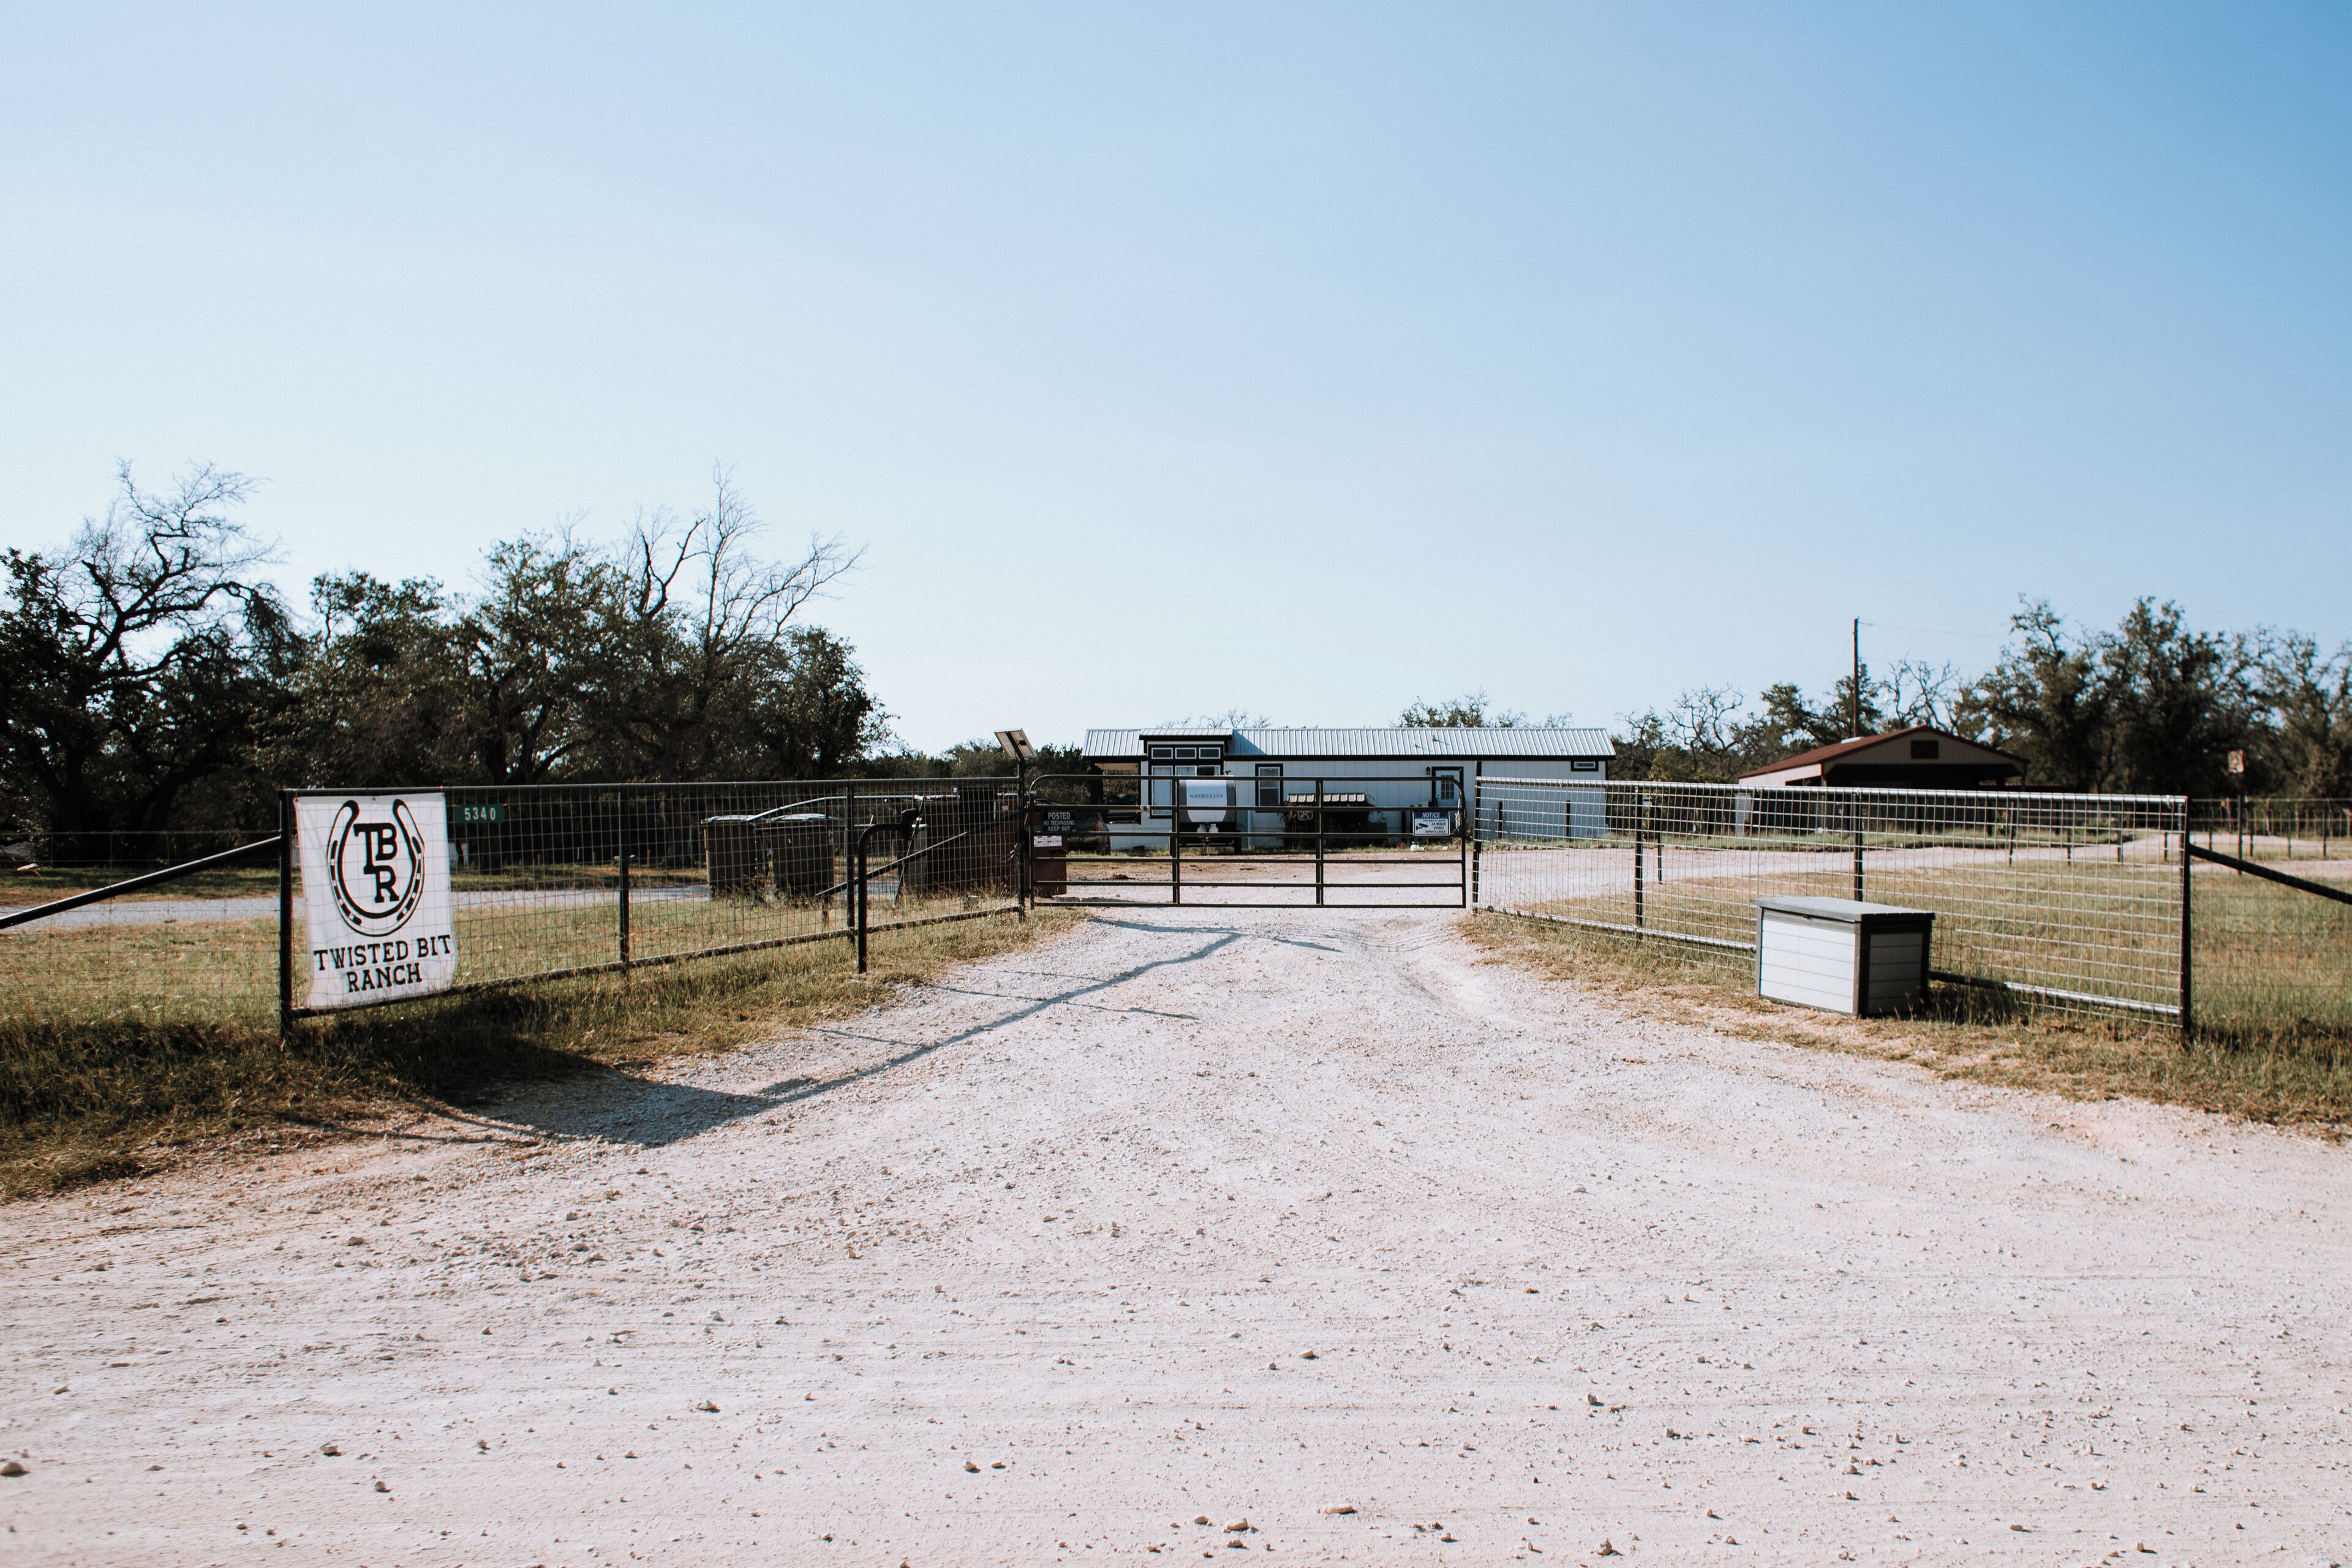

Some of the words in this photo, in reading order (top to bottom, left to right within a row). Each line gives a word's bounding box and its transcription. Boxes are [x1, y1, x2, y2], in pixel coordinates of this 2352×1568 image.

[464, 807, 496, 821] 5340
[313, 940, 409, 971] TWISTED
[417, 934, 451, 958] BIT
[346, 962, 423, 993] RANCH
